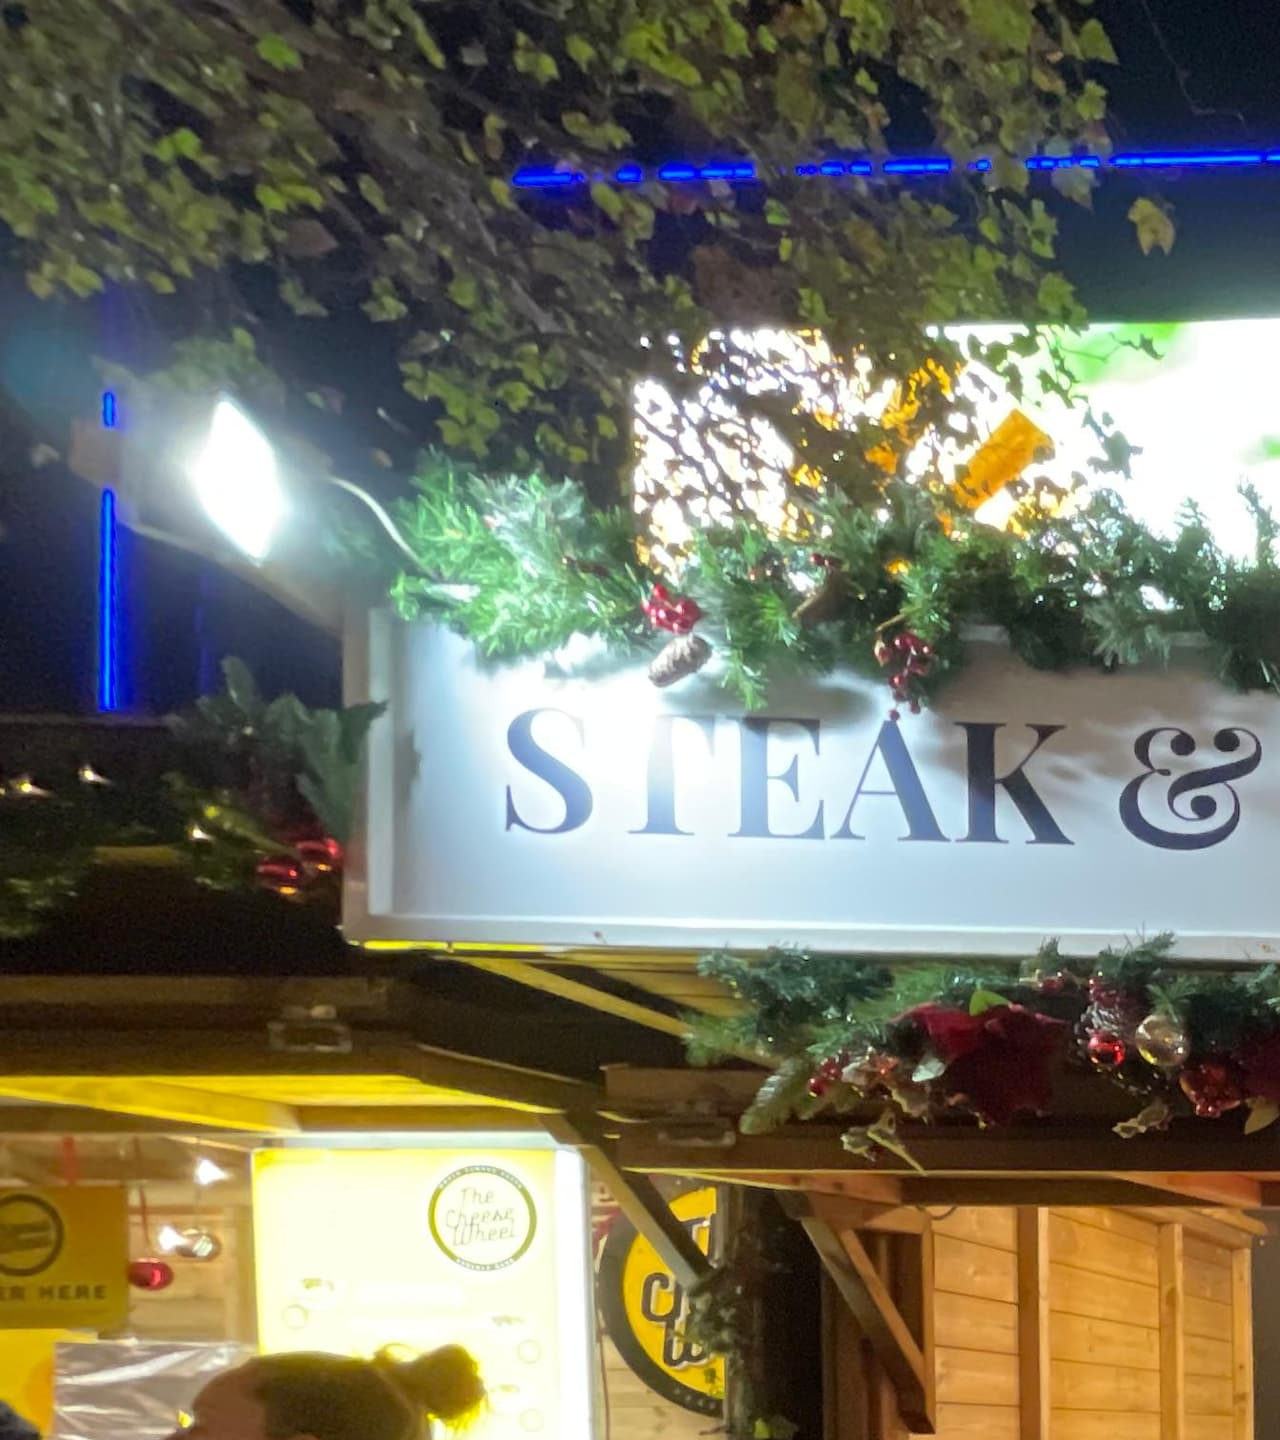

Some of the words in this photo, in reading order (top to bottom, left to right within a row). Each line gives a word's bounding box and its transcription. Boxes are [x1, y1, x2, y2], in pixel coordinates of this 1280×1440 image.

[504, 707, 1075, 846] STEAK
[1118, 726, 1262, 850] &
[38, 1284, 107, 1301] HERE
